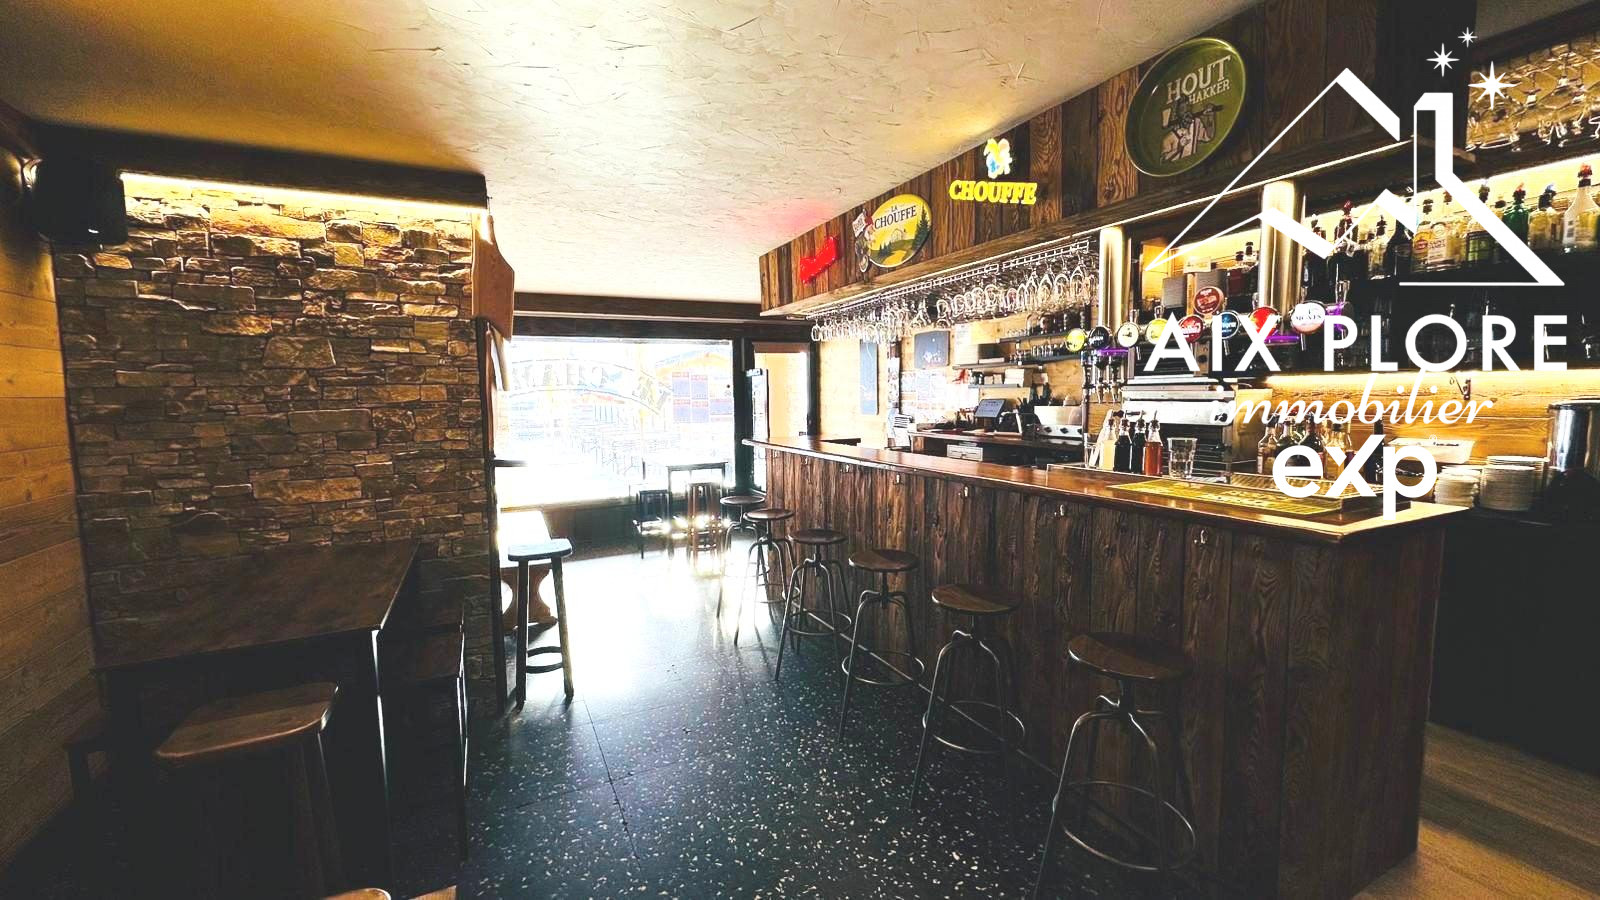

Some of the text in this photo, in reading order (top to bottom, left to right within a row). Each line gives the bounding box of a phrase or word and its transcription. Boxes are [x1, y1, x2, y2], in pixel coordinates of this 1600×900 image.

[1166, 54, 1232, 105] HOUT
[1188, 79, 1230, 105] HAKKER
[948, 179, 1038, 205] CHOUFFE
[874, 205, 917, 230] CHOUFFE
[890, 205, 898, 213] LA
